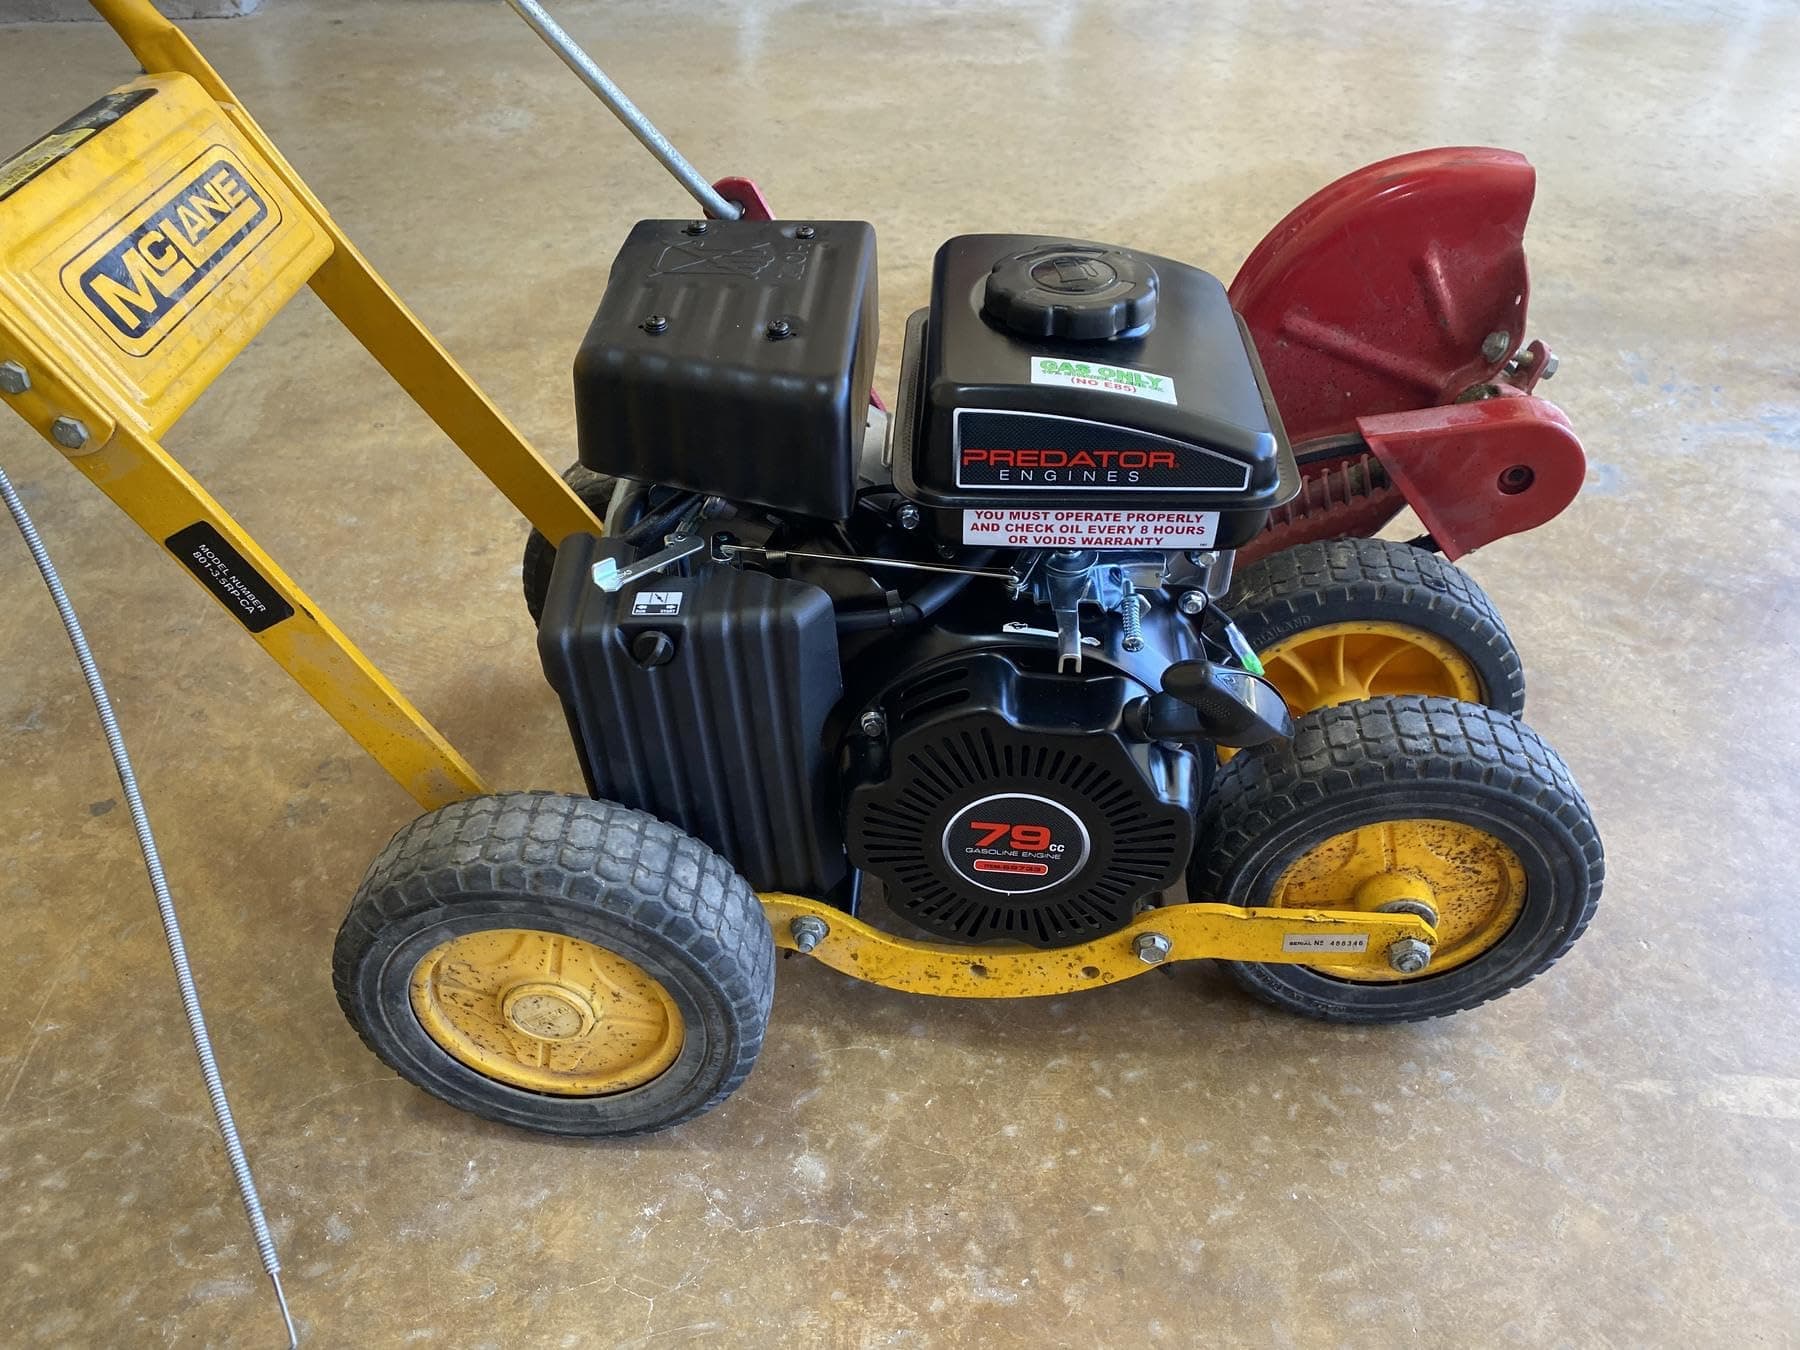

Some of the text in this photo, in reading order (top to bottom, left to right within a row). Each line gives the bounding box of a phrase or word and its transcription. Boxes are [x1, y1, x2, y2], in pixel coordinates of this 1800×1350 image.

[1040, 359, 1091, 376] GAS
[1098, 367, 1163, 388] ONLY
[1071, 377, 1099, 386] (NO
[1104, 381, 1137, 393] E85)
[962, 449, 1177, 468] PREDATOR
[1000, 469, 1139, 482] ENGINES
[975, 510, 1204, 523] YOU MUST OPERATE PROPERLY
[970, 522, 1205, 535] AND CHECK OIL EVERY 8 HOURS
[1008, 535, 1164, 546] OR VOIDS WARRANTY
[198, 544, 267, 612] MODEL NUMBER
[970, 821, 1051, 850] 79
[965, 847, 1062, 860] GASOLINE ENGINE
